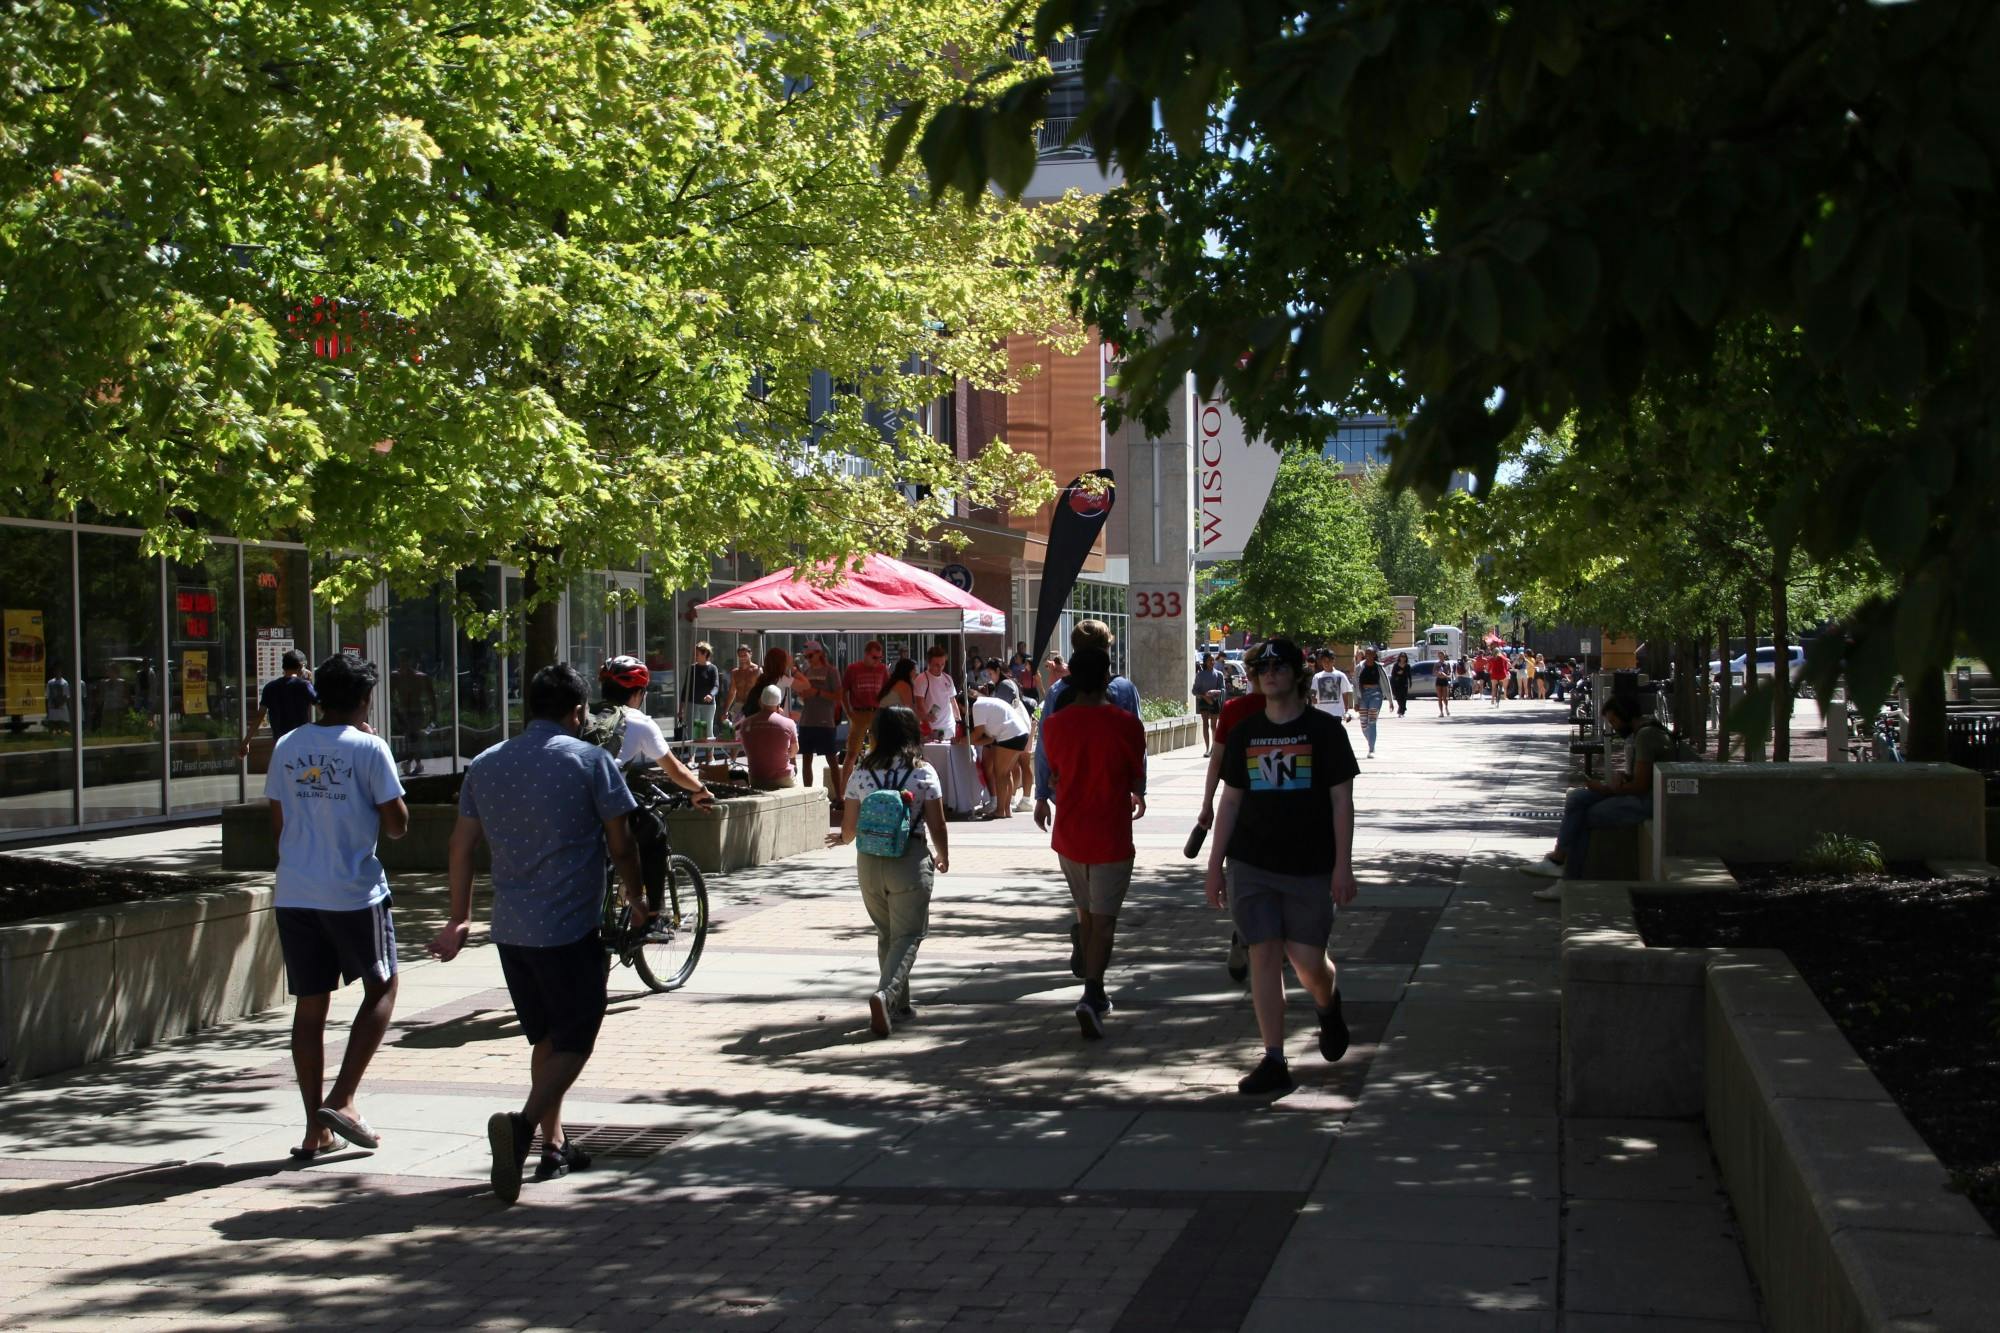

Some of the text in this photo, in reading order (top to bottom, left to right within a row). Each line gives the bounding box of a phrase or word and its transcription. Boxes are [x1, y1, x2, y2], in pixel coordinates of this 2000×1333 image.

[1202, 397, 1222, 549] WISCO
[1135, 592, 1182, 618] 333
[1250, 736, 1297, 745] NINTENDO
